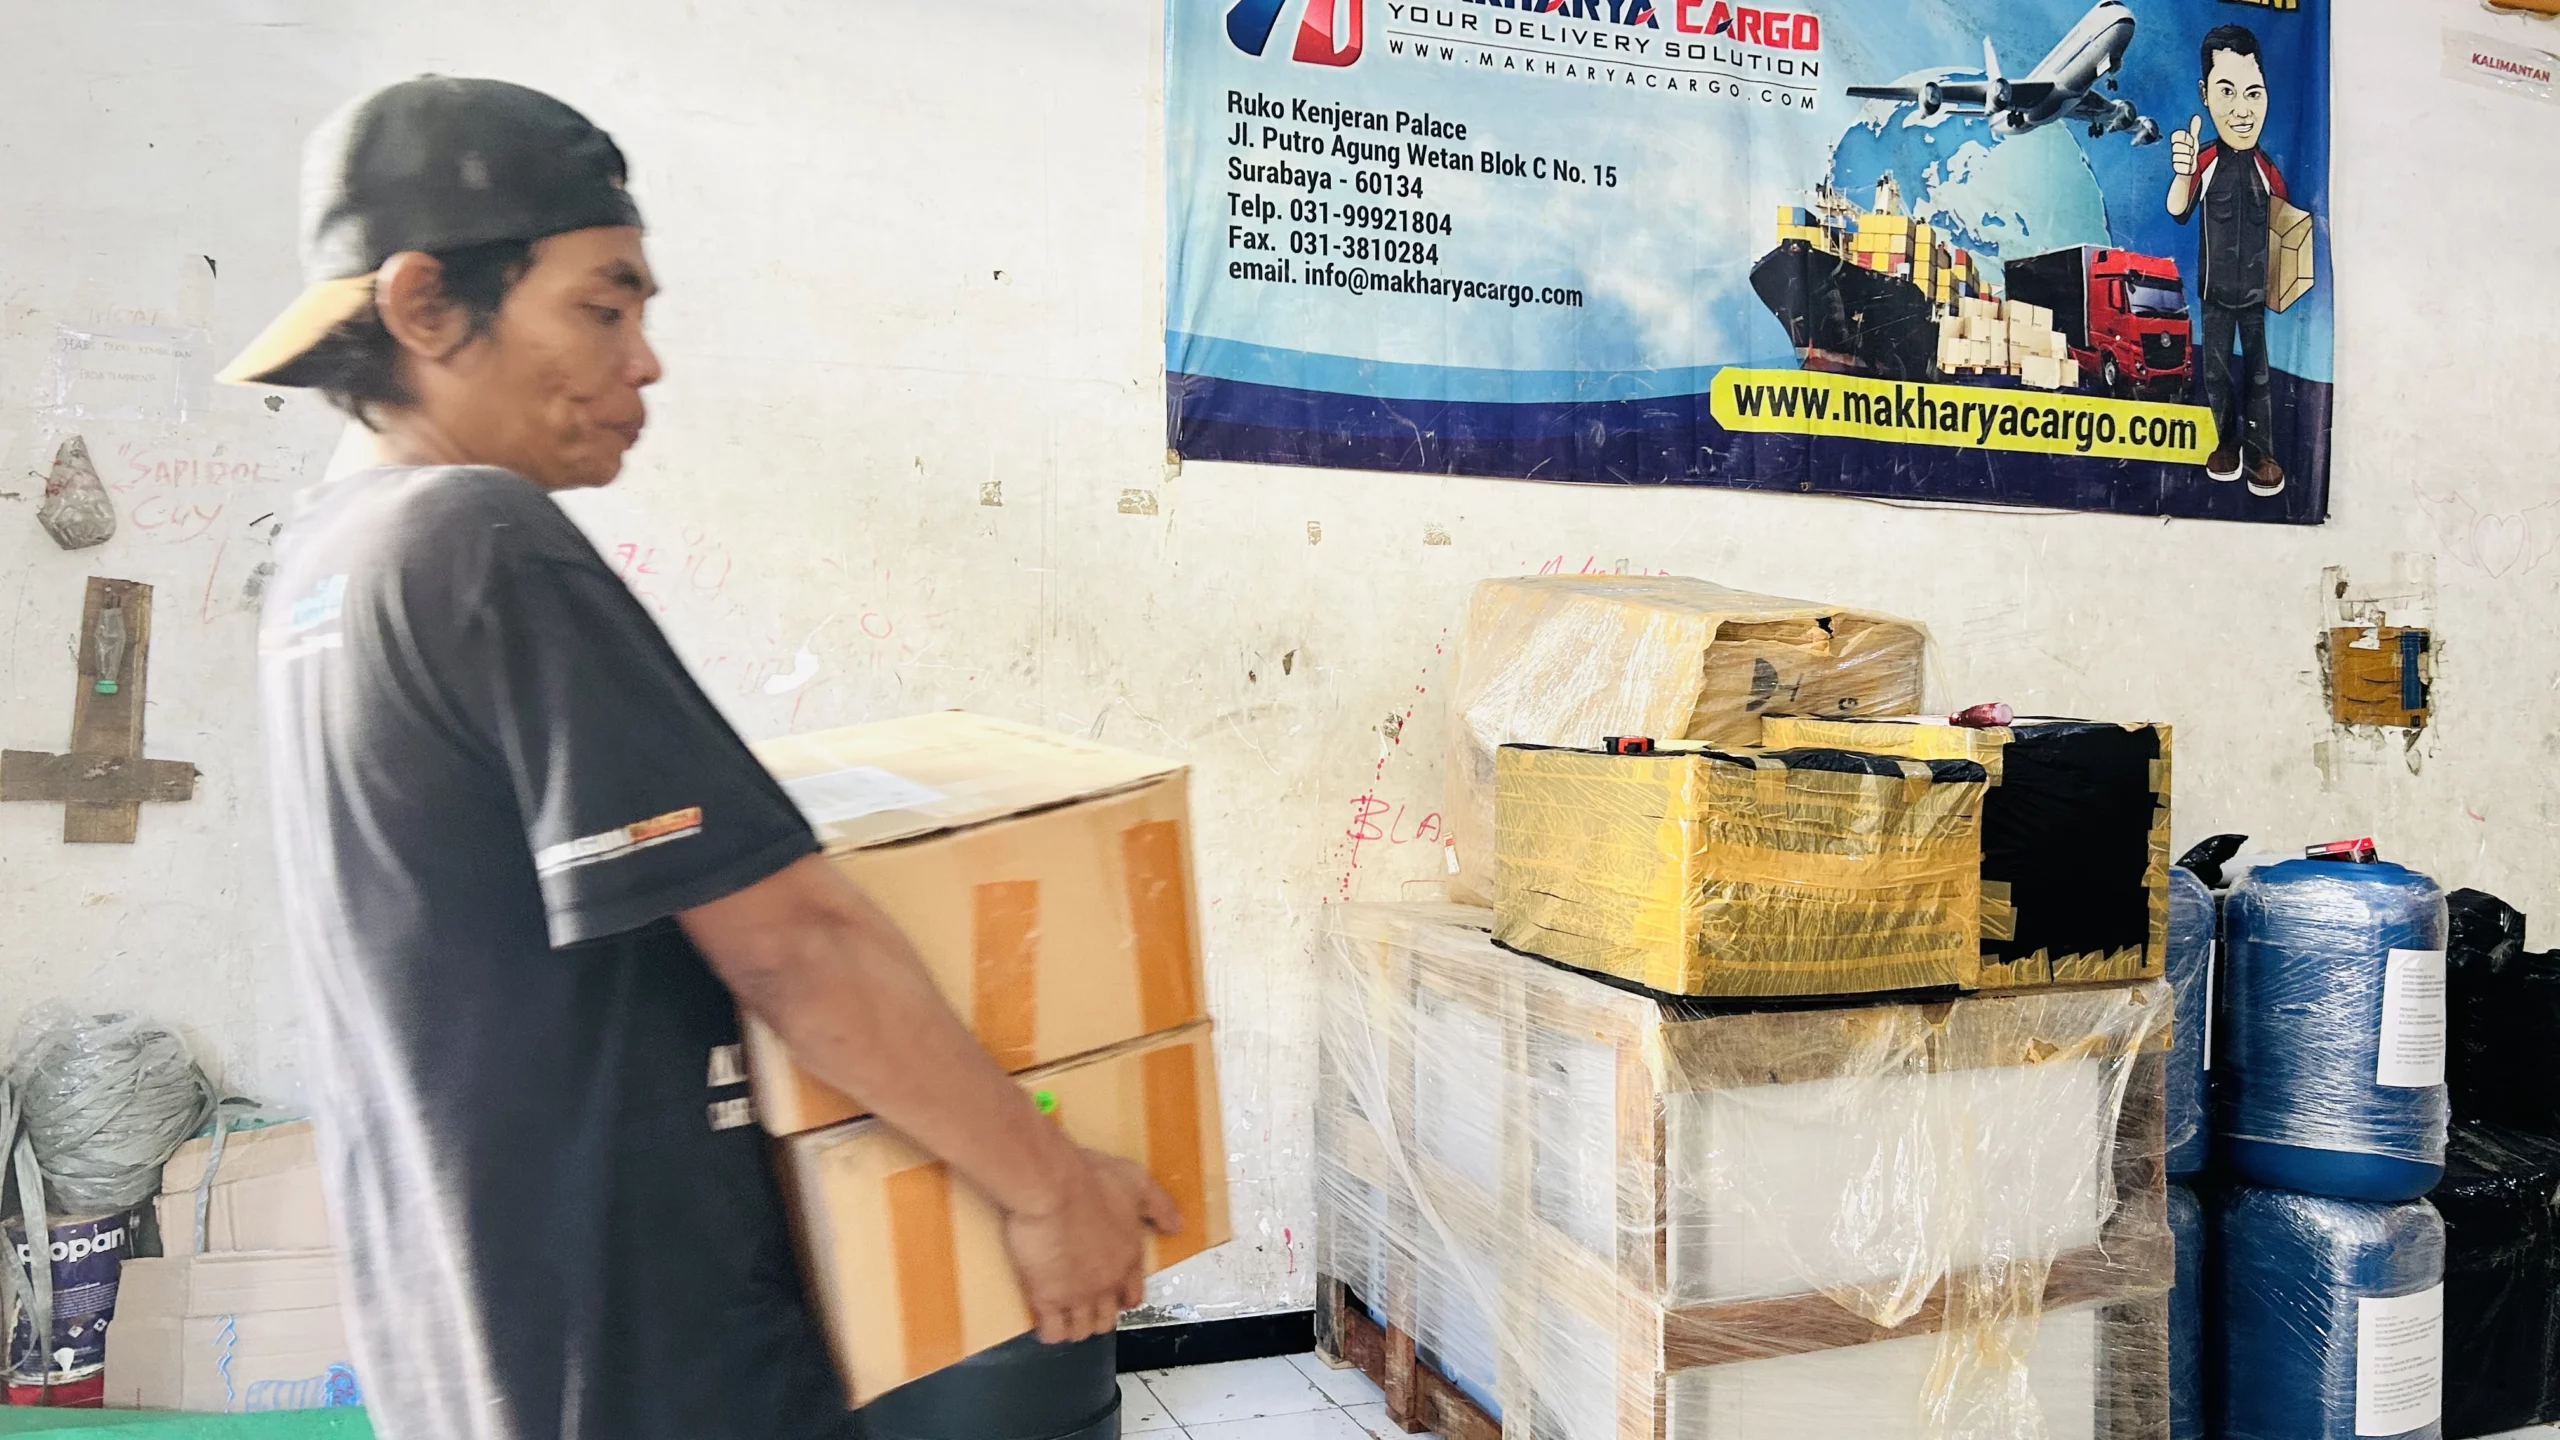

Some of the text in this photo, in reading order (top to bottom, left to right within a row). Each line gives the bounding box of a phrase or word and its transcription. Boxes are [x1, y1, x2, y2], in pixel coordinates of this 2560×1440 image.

[1388, 3, 1819, 77] YOUR DELIVERY SOLUTION
[1676, 0, 1819, 50] CARGO
[1389, 40, 1814, 109] WWW.MAKHARYACARGO.COM
[2472, 53, 2551, 82] KALIMANTAN
[1227, 90, 1467, 140] Ruko Kenjeran Palace
[1227, 122, 1617, 187] Jl. Putro Agung Wetan Blok C No. 15
[1228, 156, 1332, 194] Surabaya
[1356, 170, 1423, 199] 60134
[1228, 192, 1452, 236] Telp. 031-99921804
[1229, 226, 1438, 266] Fax. 031-3810284
[1229, 258, 1583, 308] email. info@makharyacargo.com
[1733, 384, 2197, 452] www.makharyacargo.com
[17, 1227, 125, 1263] popan
